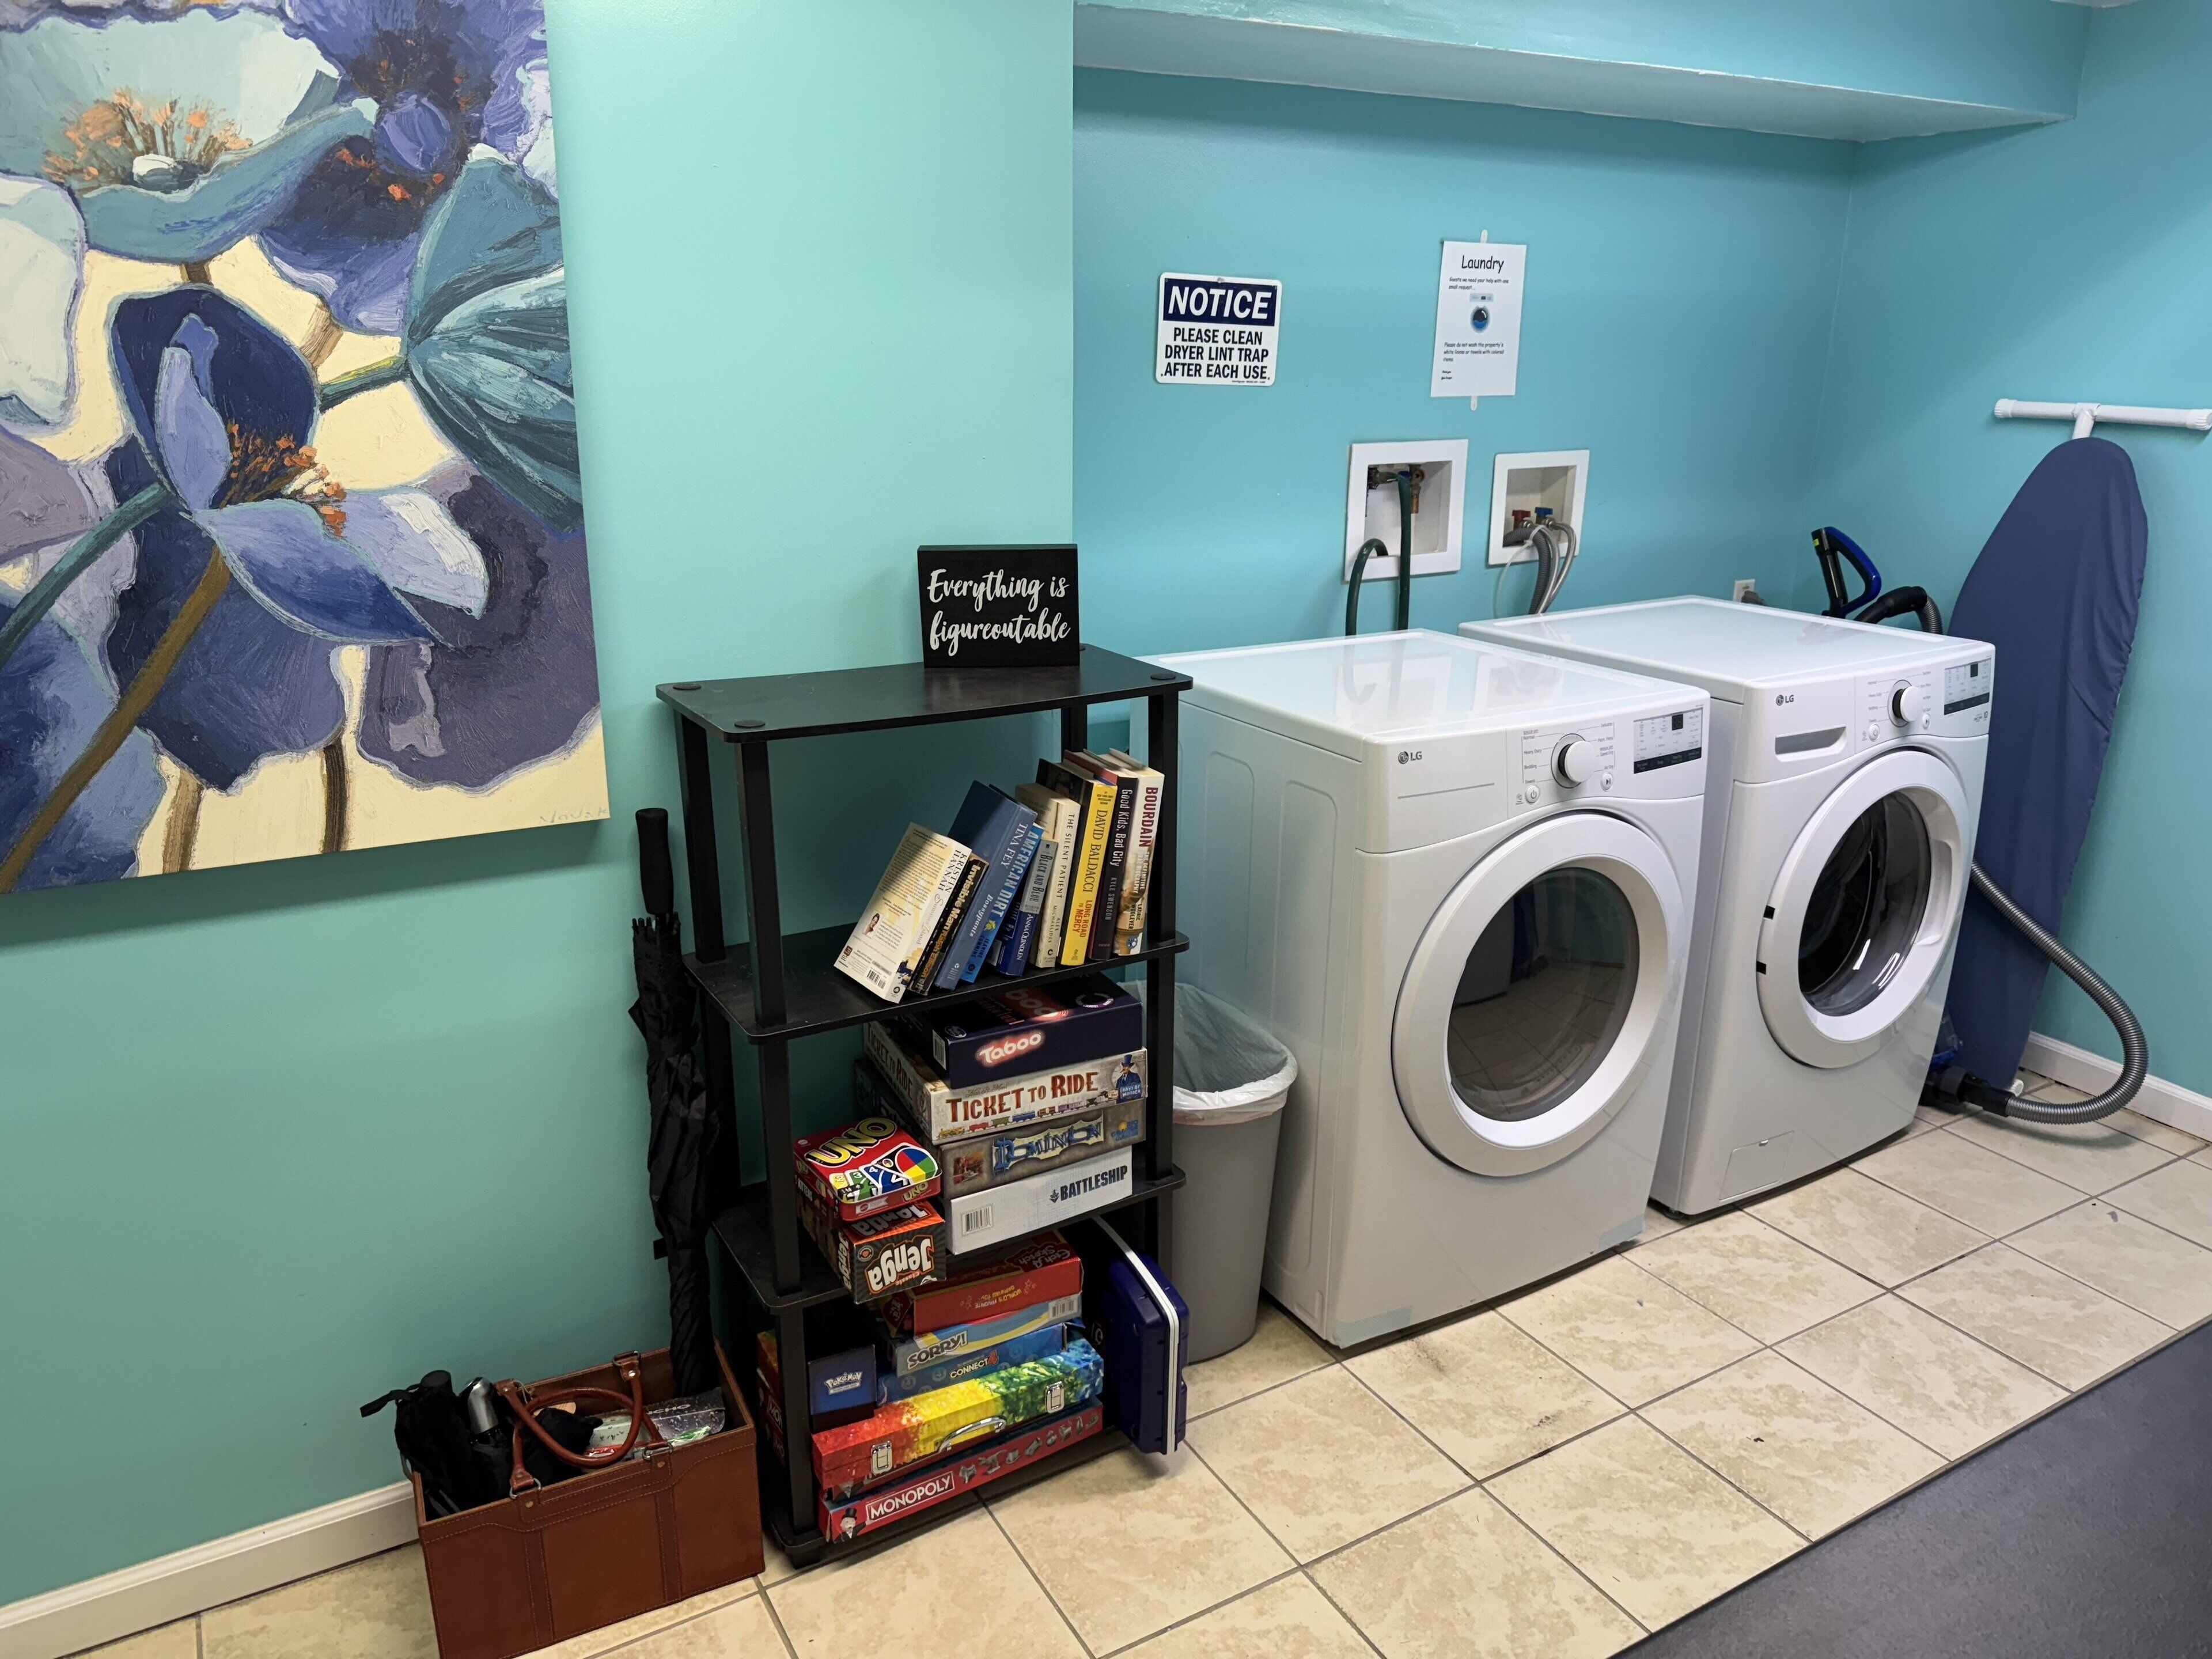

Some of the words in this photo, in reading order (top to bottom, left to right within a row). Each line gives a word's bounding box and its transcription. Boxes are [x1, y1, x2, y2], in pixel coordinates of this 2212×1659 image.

[1461, 255, 1504, 274] Laundry
[1168, 286, 1272, 319] NOTICE
[1173, 327, 1219, 343] PLEASE
[1223, 330, 1263, 345] CLEAN
[1165, 344, 1204, 360] DRYER
[1209, 347, 1234, 361] LINT
[1238, 348, 1268, 362] TRAP
[1164, 362, 1202, 377] AFTER
[1206, 363, 1238, 378] EACH
[927, 569, 1044, 612] Everything
[1050, 577, 1070, 597] is
[930, 607, 1071, 657] figureoutable
[1785, 694, 1794, 703] LG
[1410, 751, 1422, 761] LG
[1120, 788, 1132, 810] Good
[1093, 809, 1108, 840] DAVID
[1139, 787, 1158, 848] BOURDAIN
[1009, 824, 1028, 847] TINA
[1063, 834, 1072, 861] SILENT
[1115, 834, 1126, 849] Bad
[938, 849, 962, 891] HANNAH
[1001, 847, 1016, 869] FEY
[1004, 831, 1039, 890] AMERICAN
[1037, 854, 1053, 875] BLACK
[1082, 843, 1101, 893] BALDACCI
[1110, 850, 1124, 867] City
[945, 852, 968, 893] KRISTIN
[954, 864, 981, 908] Invisible
[1057, 865, 1067, 898] PATIENT
[1132, 865, 1142, 893] BIOGRAPHY
[991, 888, 1013, 918] DIRT
[1029, 885, 1044, 903] BLUE
[1105, 893, 1115, 921] SWENSON
[943, 906, 961, 931] Man
[969, 894, 994, 937] Bossypants
[1023, 914, 1033, 932] ANNA
[1048, 906, 1058, 943] MICHAELIDES
[1073, 909, 1084, 934] MERCY
[1080, 920, 1089, 938] ROAD
[978, 938, 990, 959] JEANINE
[1005, 989, 1058, 1017] boo
[979, 1033, 1041, 1063] Taboo
[946, 1087, 1024, 1122] TICKET
[1028, 1086, 1047, 1103] TO
[1051, 1071, 1098, 1099] RIDE
[806, 1118, 896, 1165] UNO
[993, 1122, 1103, 1174] DOMINION
[903, 1181, 928, 1202] UNO
[1060, 1165, 1128, 1201] BATTLESHIP
[838, 1231, 852, 1291] Jenga
[868, 1238, 931, 1291] Jenga
[1019, 1245, 1055, 1264] Sketch
[1033, 1258, 1043, 1268] A
[1045, 1249, 1070, 1263] Etch
[895, 1271, 920, 1286] Classic
[998, 1289, 1022, 1302] WORLD'S
[907, 1330, 968, 1369] SORRY!
[950, 1358, 988, 1378] CONNECT
[987, 1350, 999, 1365] 4
[870, 1475, 950, 1519] MONOPOLY
